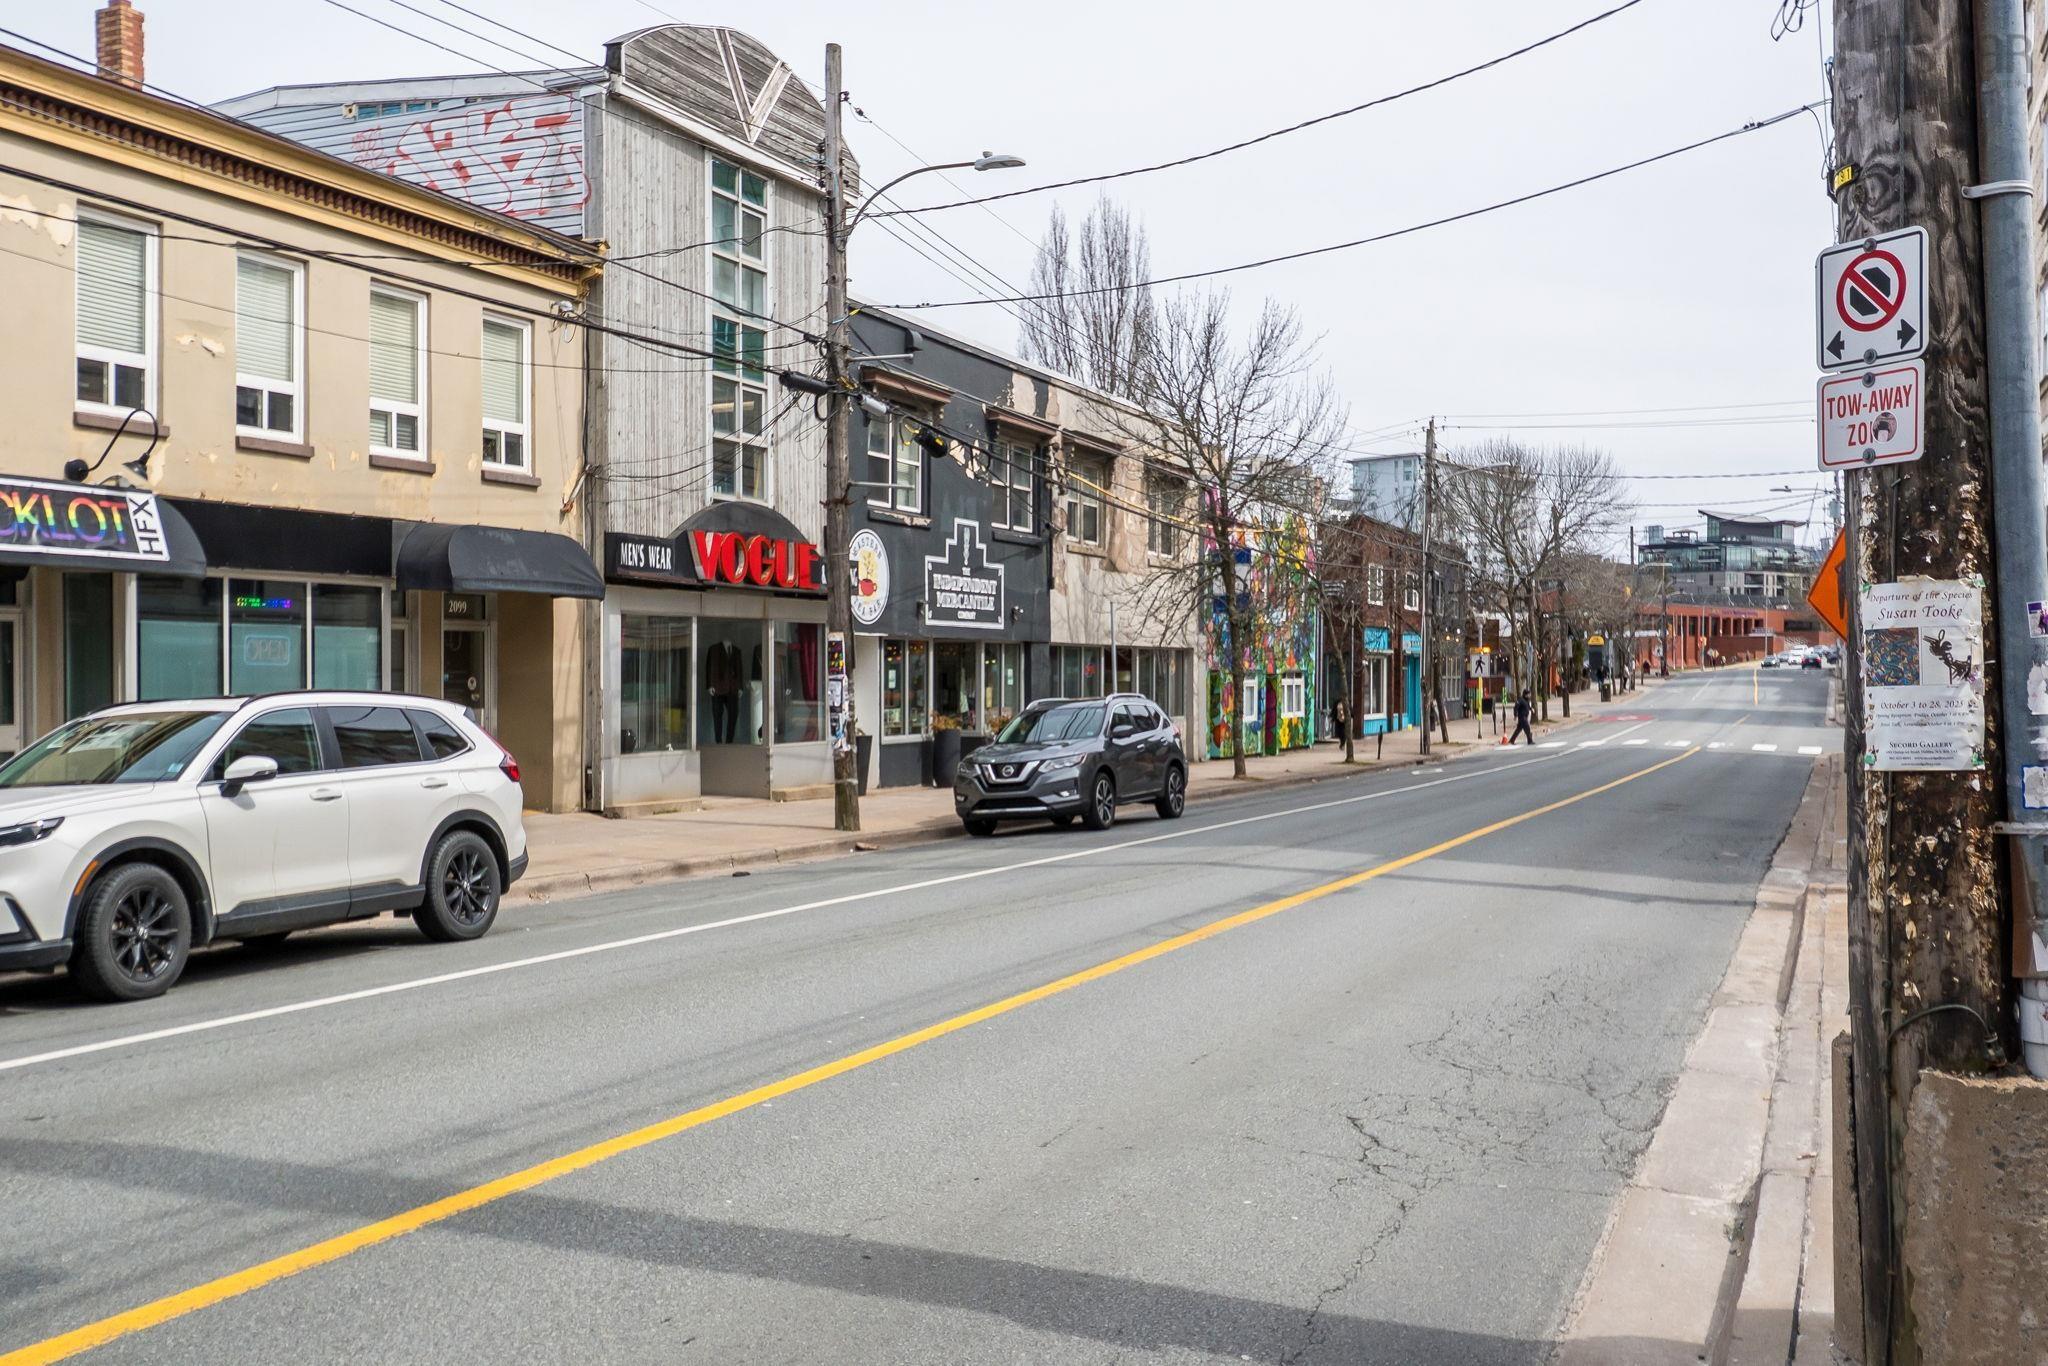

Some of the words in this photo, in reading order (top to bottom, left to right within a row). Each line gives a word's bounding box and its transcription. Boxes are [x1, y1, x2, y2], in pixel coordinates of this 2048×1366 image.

[1826, 384, 1913, 419] TOW-AWAY
[132, 498, 164, 556] HFX
[620, 542, 644, 568] MEN'S
[648, 543, 672, 570] WEAR
[690, 529, 821, 590] VOGUE
[933, 573, 998, 595] INDEPENDENT
[448, 600, 467, 614] 2099
[936, 591, 995, 611] MERCANTILE
[1870, 593, 1910, 604] Departure
[1912, 591, 1924, 602] of
[1925, 590, 1940, 600] the
[1942, 590, 1973, 602] Species
[1878, 607, 1917, 621] Susan
[1922, 603, 1963, 620] Tooke
[247, 639, 288, 661] OPEN
[1880, 701, 1909, 710] October
[1918, 701, 1927, 709] to
